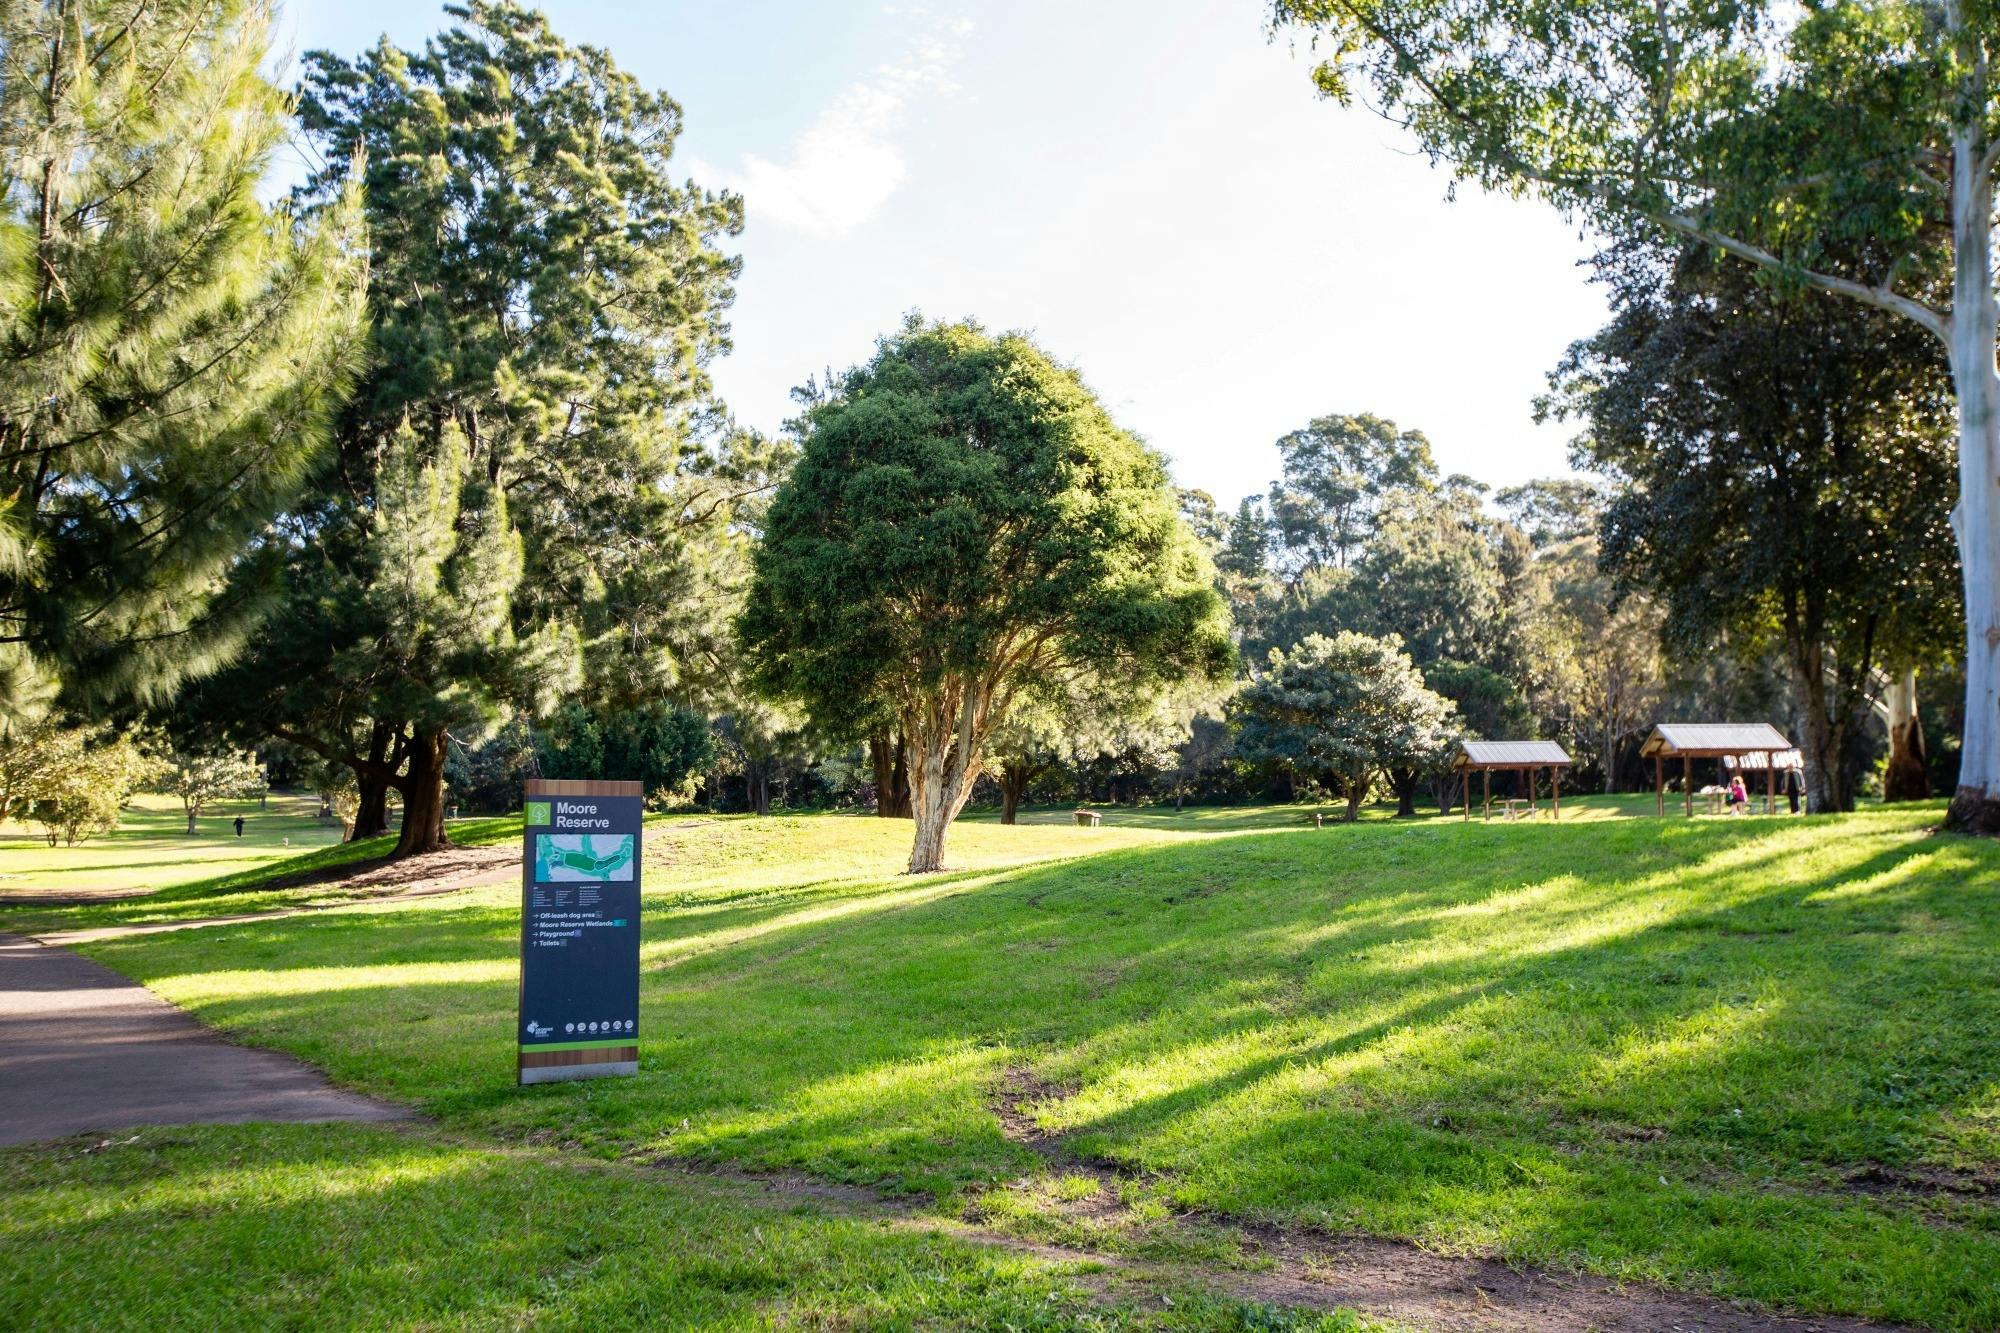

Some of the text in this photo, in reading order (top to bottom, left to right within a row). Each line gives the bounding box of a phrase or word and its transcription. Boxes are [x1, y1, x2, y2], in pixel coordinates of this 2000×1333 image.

[557, 802, 597, 814] Moore
[556, 816, 609, 828] Reserve
[539, 930, 575, 938] Playground
